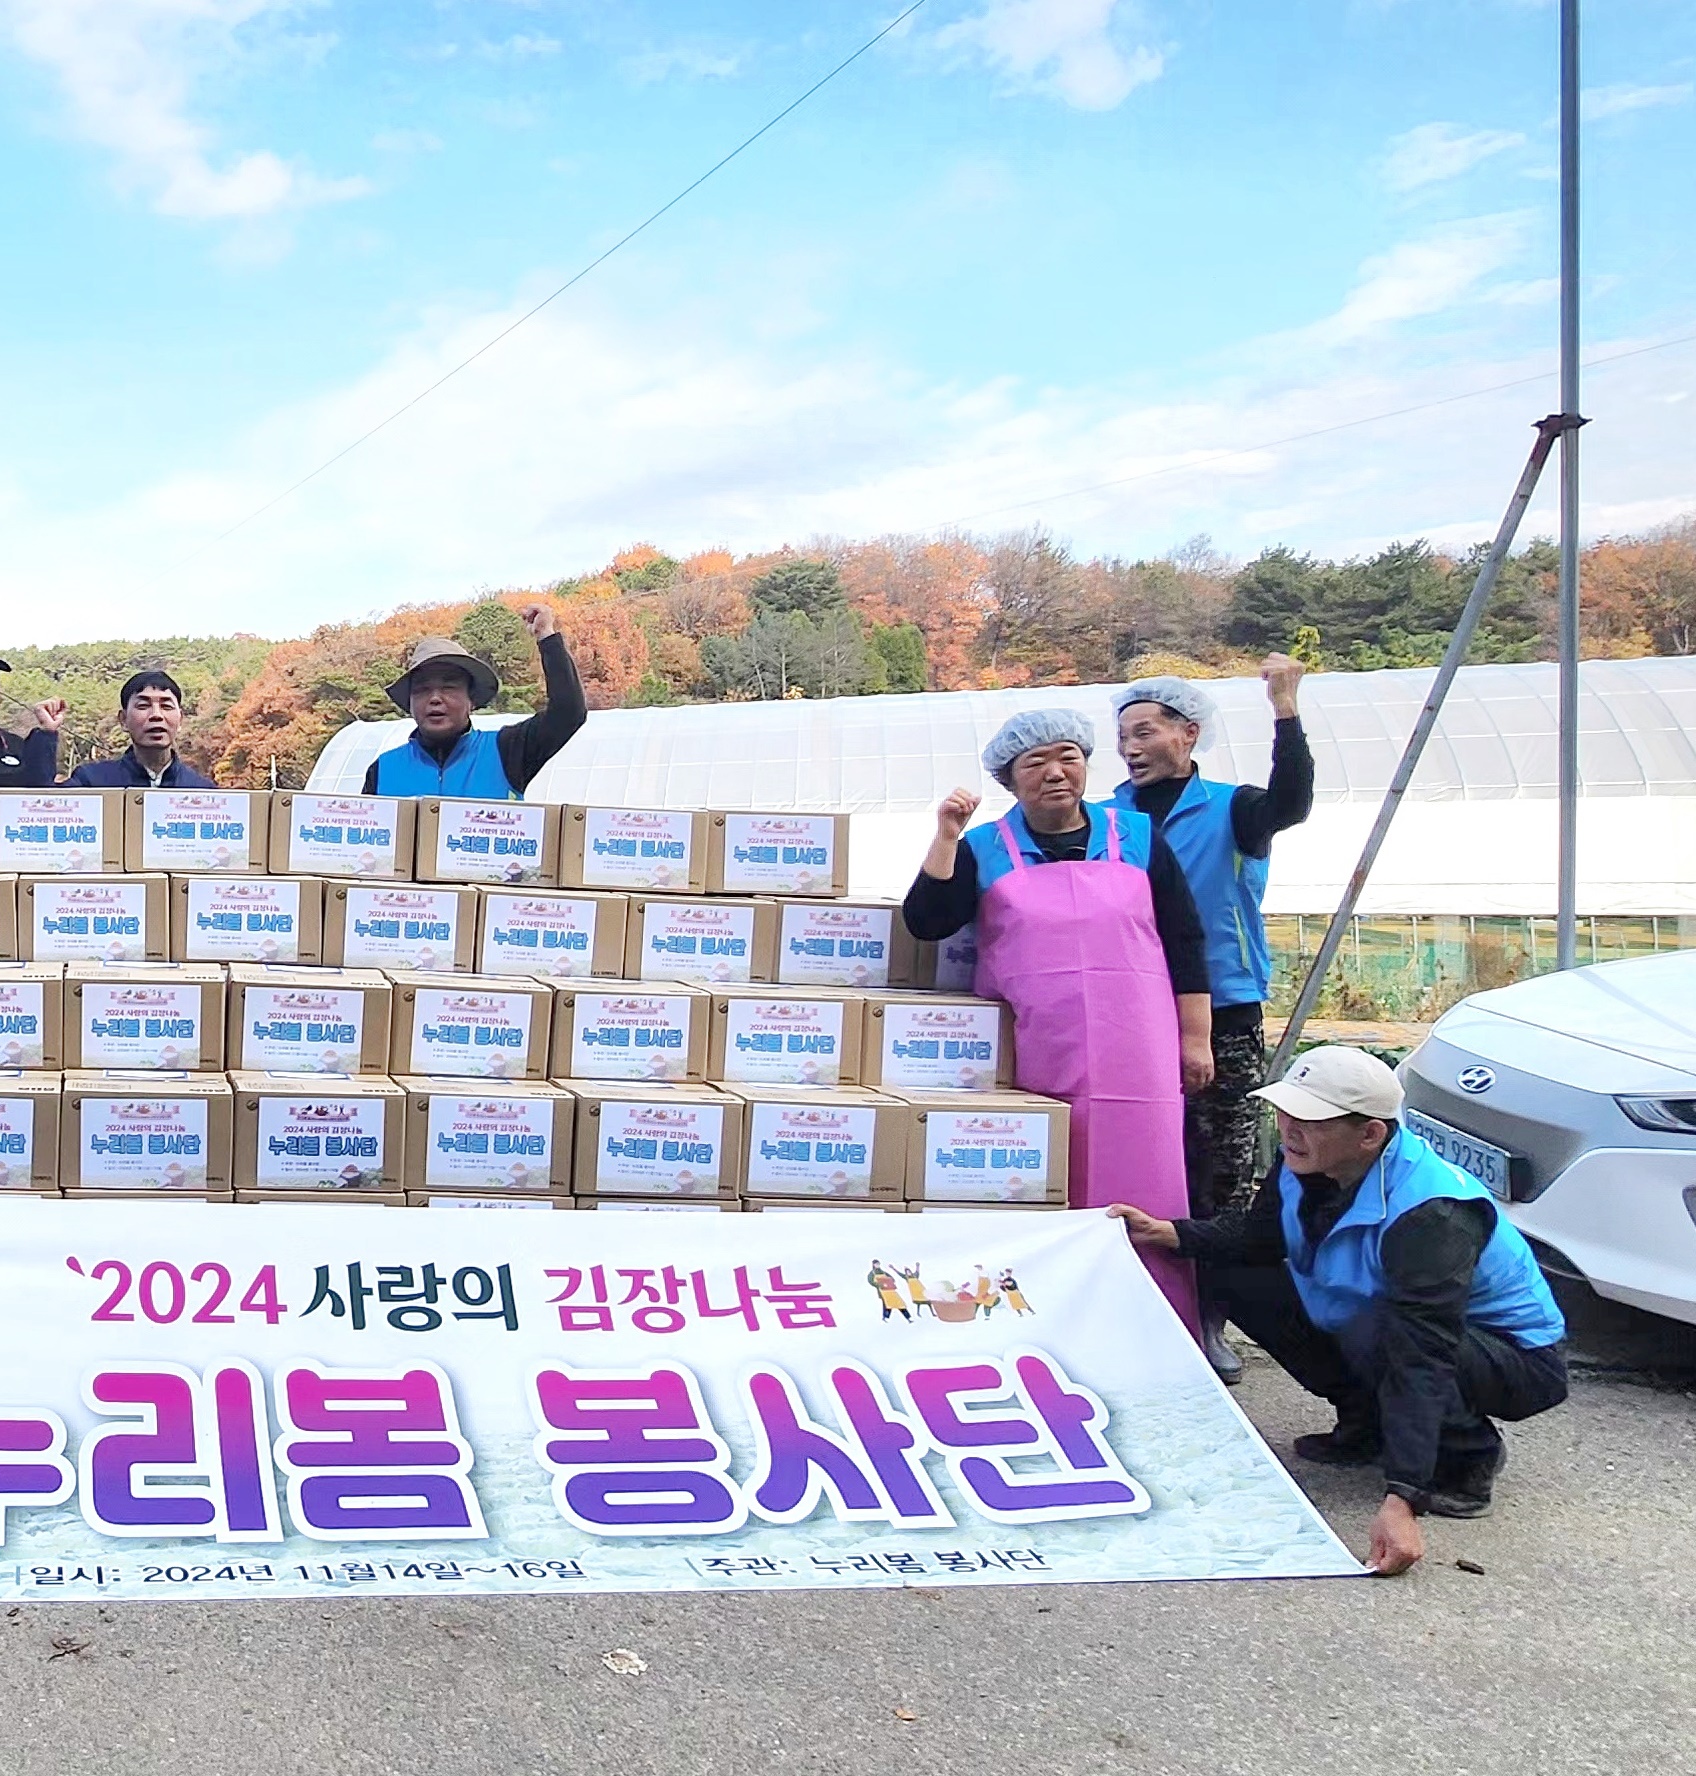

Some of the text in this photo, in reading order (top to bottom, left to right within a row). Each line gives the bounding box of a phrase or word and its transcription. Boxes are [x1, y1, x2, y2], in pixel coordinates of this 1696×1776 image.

[5, 826, 97, 842] 누리봄 봉사단
[152, 823, 244, 839] 누리봄 봉사단
[299, 826, 391, 845] 누리봄 봉사단
[446, 835, 538, 856] 누리봄 봉사단
[641, 840, 685, 858] 봉사단
[782, 847, 827, 864] 봉사단
[56, 908, 75, 916] 2024
[43, 917, 140, 934] 누리봄 봉사단
[197, 913, 293, 932] 누리봄 봉사단
[354, 920, 451, 940] 누리봄 봉사단
[493, 928, 589, 950] 누리봄 봉사단
[701, 938, 747, 956] 봉사단
[839, 940, 885, 959] 봉사단
[105, 1009, 125, 1017] 2024
[268, 1012, 288, 1020] 2024
[91, 1019, 195, 1038] 누리봄 봉사단
[253, 1022, 357, 1043] 누리봄 봉사단
[422, 1024, 524, 1047] 누리봄 봉사단
[582, 1028, 683, 1047] 누리봄 봉사단
[788, 1034, 835, 1054] 봉사단
[944, 1041, 993, 1060] 봉사단
[105, 1123, 126, 1132] 2024
[282, 1125, 303, 1134] 2024
[452, 1122, 474, 1131] 2024
[622, 1127, 643, 1136] 2024
[775, 1130, 796, 1138] 2024
[90, 1134, 202, 1155] 누리봄 봉사단
[267, 1136, 379, 1157] 누리봄 봉사단
[436, 1132, 546, 1155] 누리봄 봉사단
[606, 1137, 714, 1164] 누리봄 봉사단
[950, 1138, 971, 1146] 2024
[759, 1140, 867, 1164] 누리봄 봉사단
[935, 1148, 1042, 1169] 누리봄 봉사단
[1451, 1140, 1496, 1184] 9235
[299, 1259, 519, 1332] 사랑의
[545, 1264, 837, 1333] 김장나눔
[534, 1355, 1137, 1525] 봉사단
[30, 1559, 585, 1586] 일시: 2024년 11월14일~16일
[701, 1549, 1053, 1577] 주관: 누리봄 봉사단
